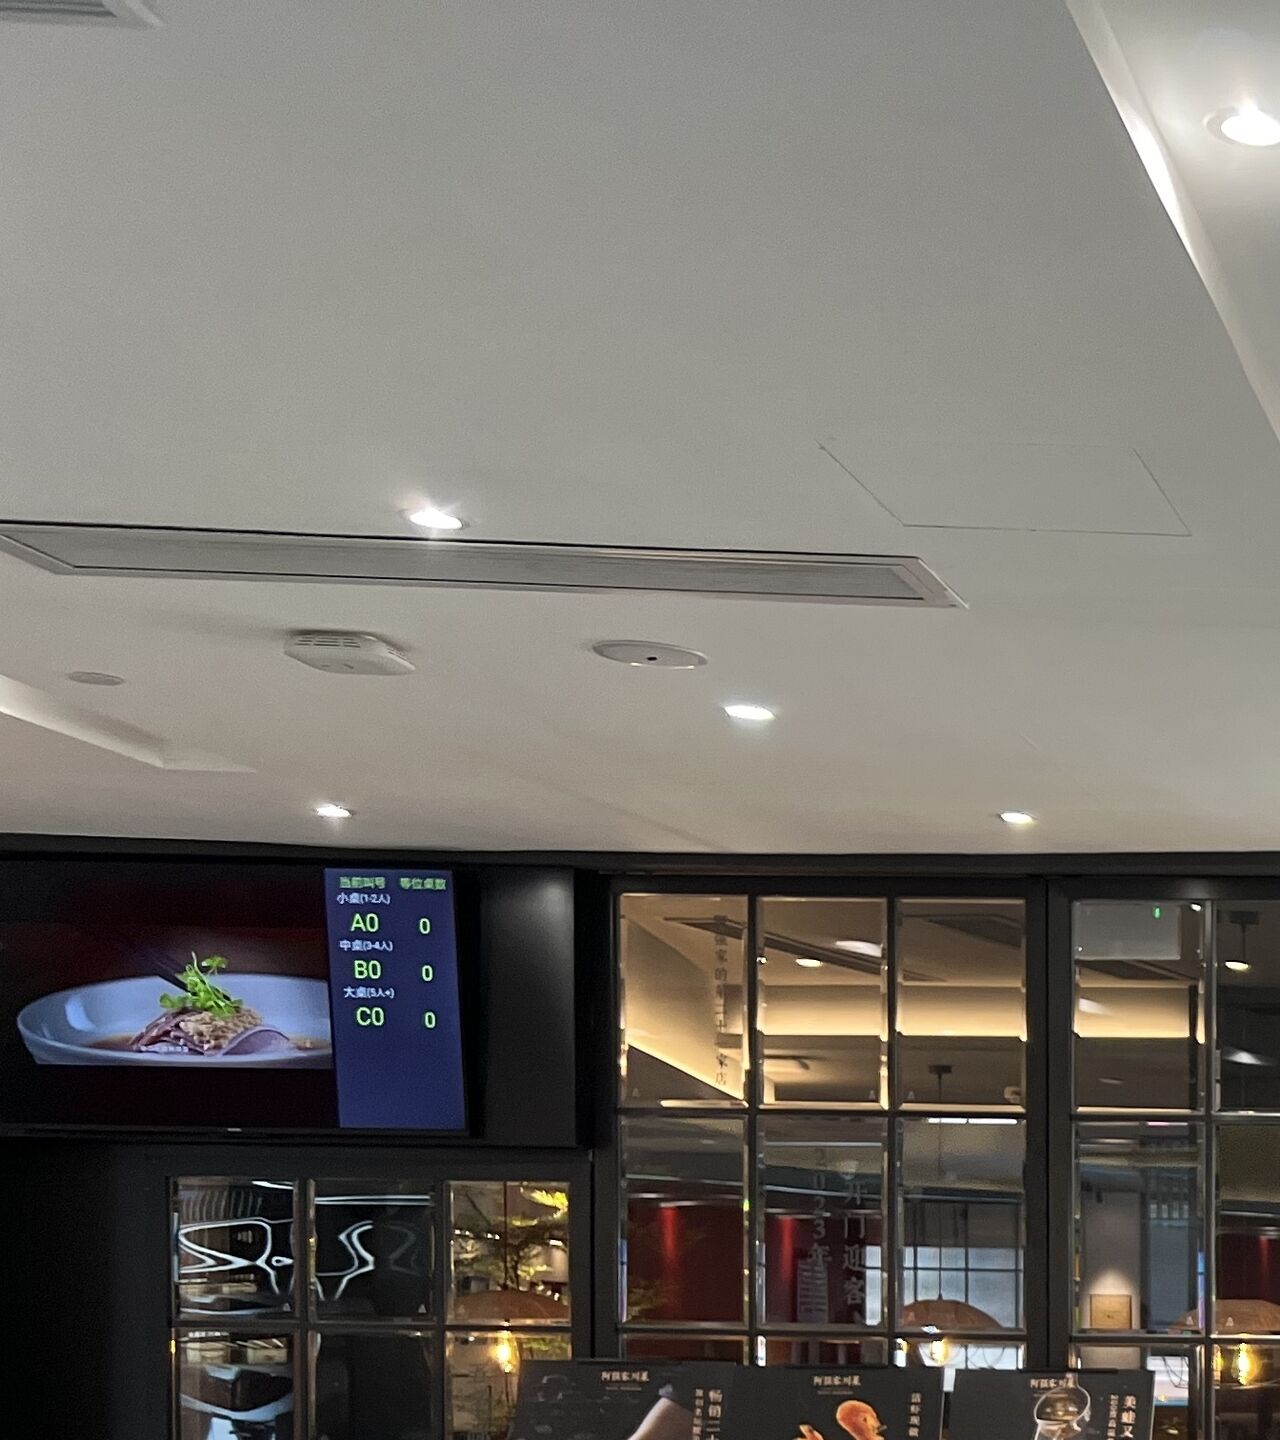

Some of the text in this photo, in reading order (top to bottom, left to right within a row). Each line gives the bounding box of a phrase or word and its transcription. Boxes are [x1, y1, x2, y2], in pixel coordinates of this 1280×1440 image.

[339, 876, 447, 891] 当前叫号 等位桌数
[350, 912, 432, 935] A0 0
[353, 959, 434, 982] B0 0
[355, 1006, 437, 1029] C0 0
